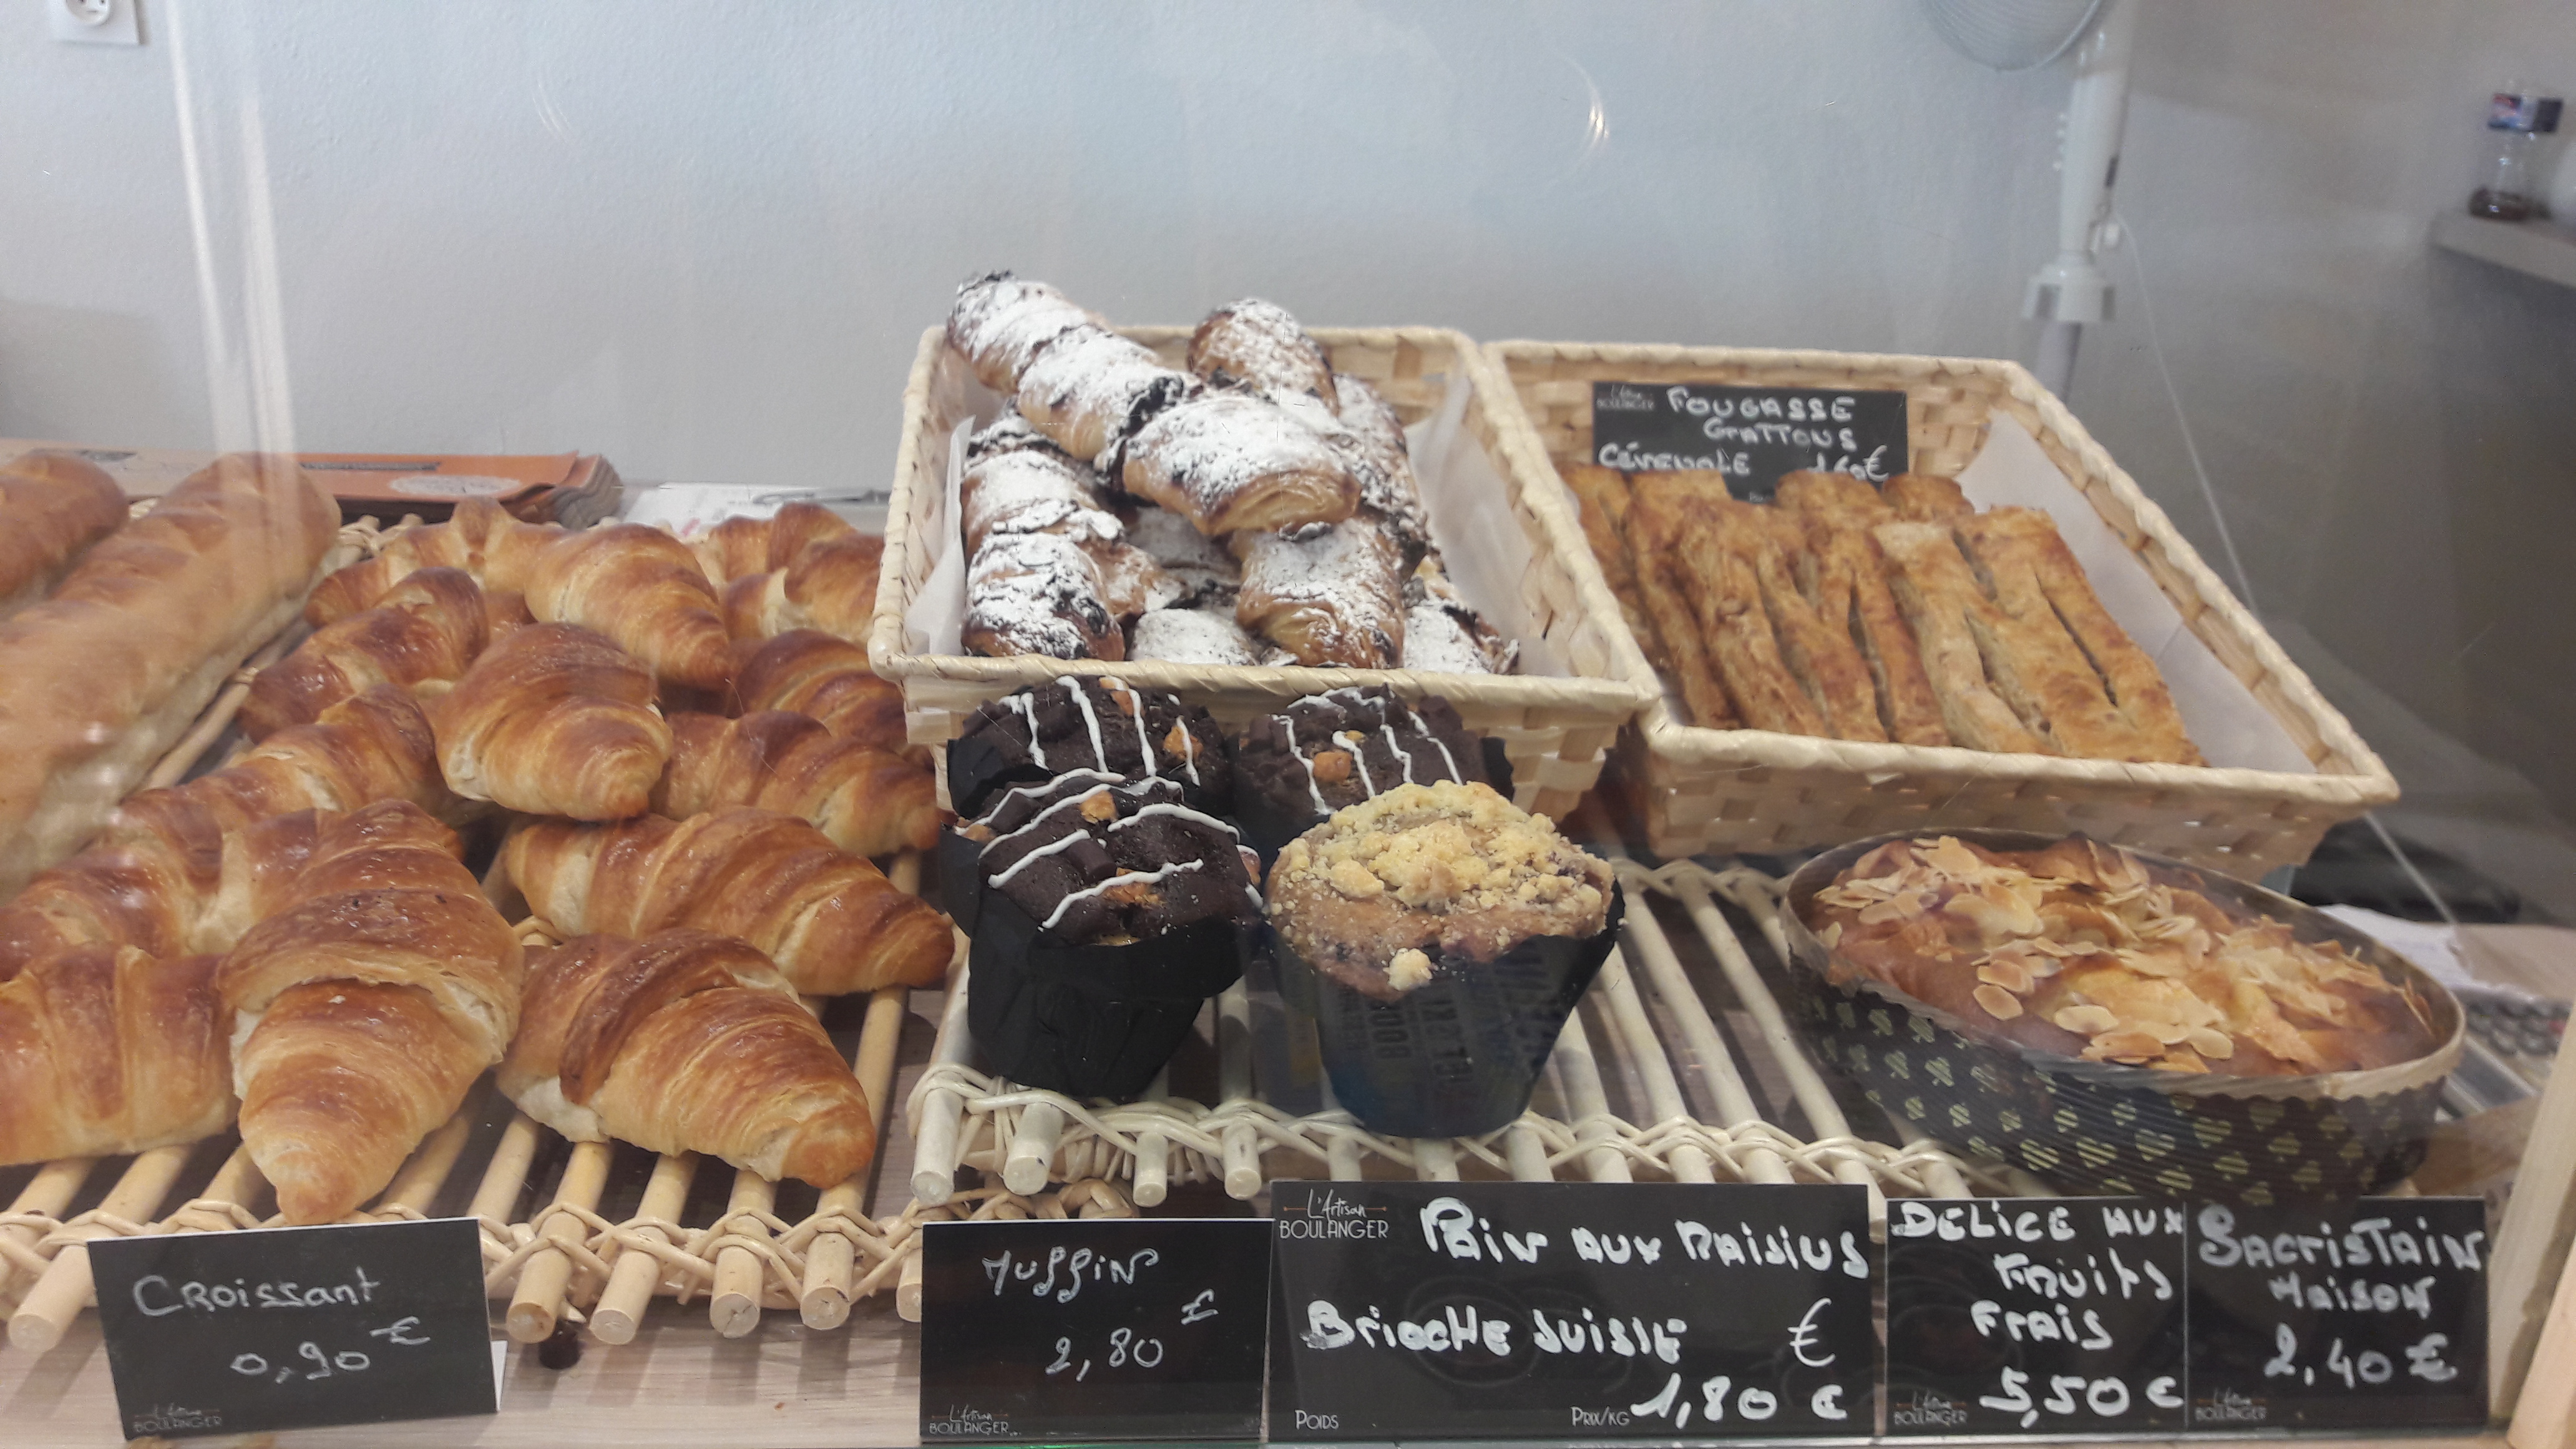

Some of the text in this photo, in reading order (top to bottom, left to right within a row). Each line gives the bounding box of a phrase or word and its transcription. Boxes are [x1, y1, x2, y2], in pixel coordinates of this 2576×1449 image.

[1305, 1188, 1368, 1222] L'Artisan
[1279, 1218, 1388, 1239] BOULANGER
[1788, 1299, 1835, 1367] €
[230, 1342, 370, 1383] 0,90
[2265, 1324, 2391, 1388] 2,40
[1631, 1373, 1847, 1428] 1,80 €
[1979, 1367, 2129, 1428] 5,50
[2147, 1377, 2183, 1407] €
[929, 1421, 1010, 1435] BOULANGER
[1295, 1410, 1339, 1430] POIDS
